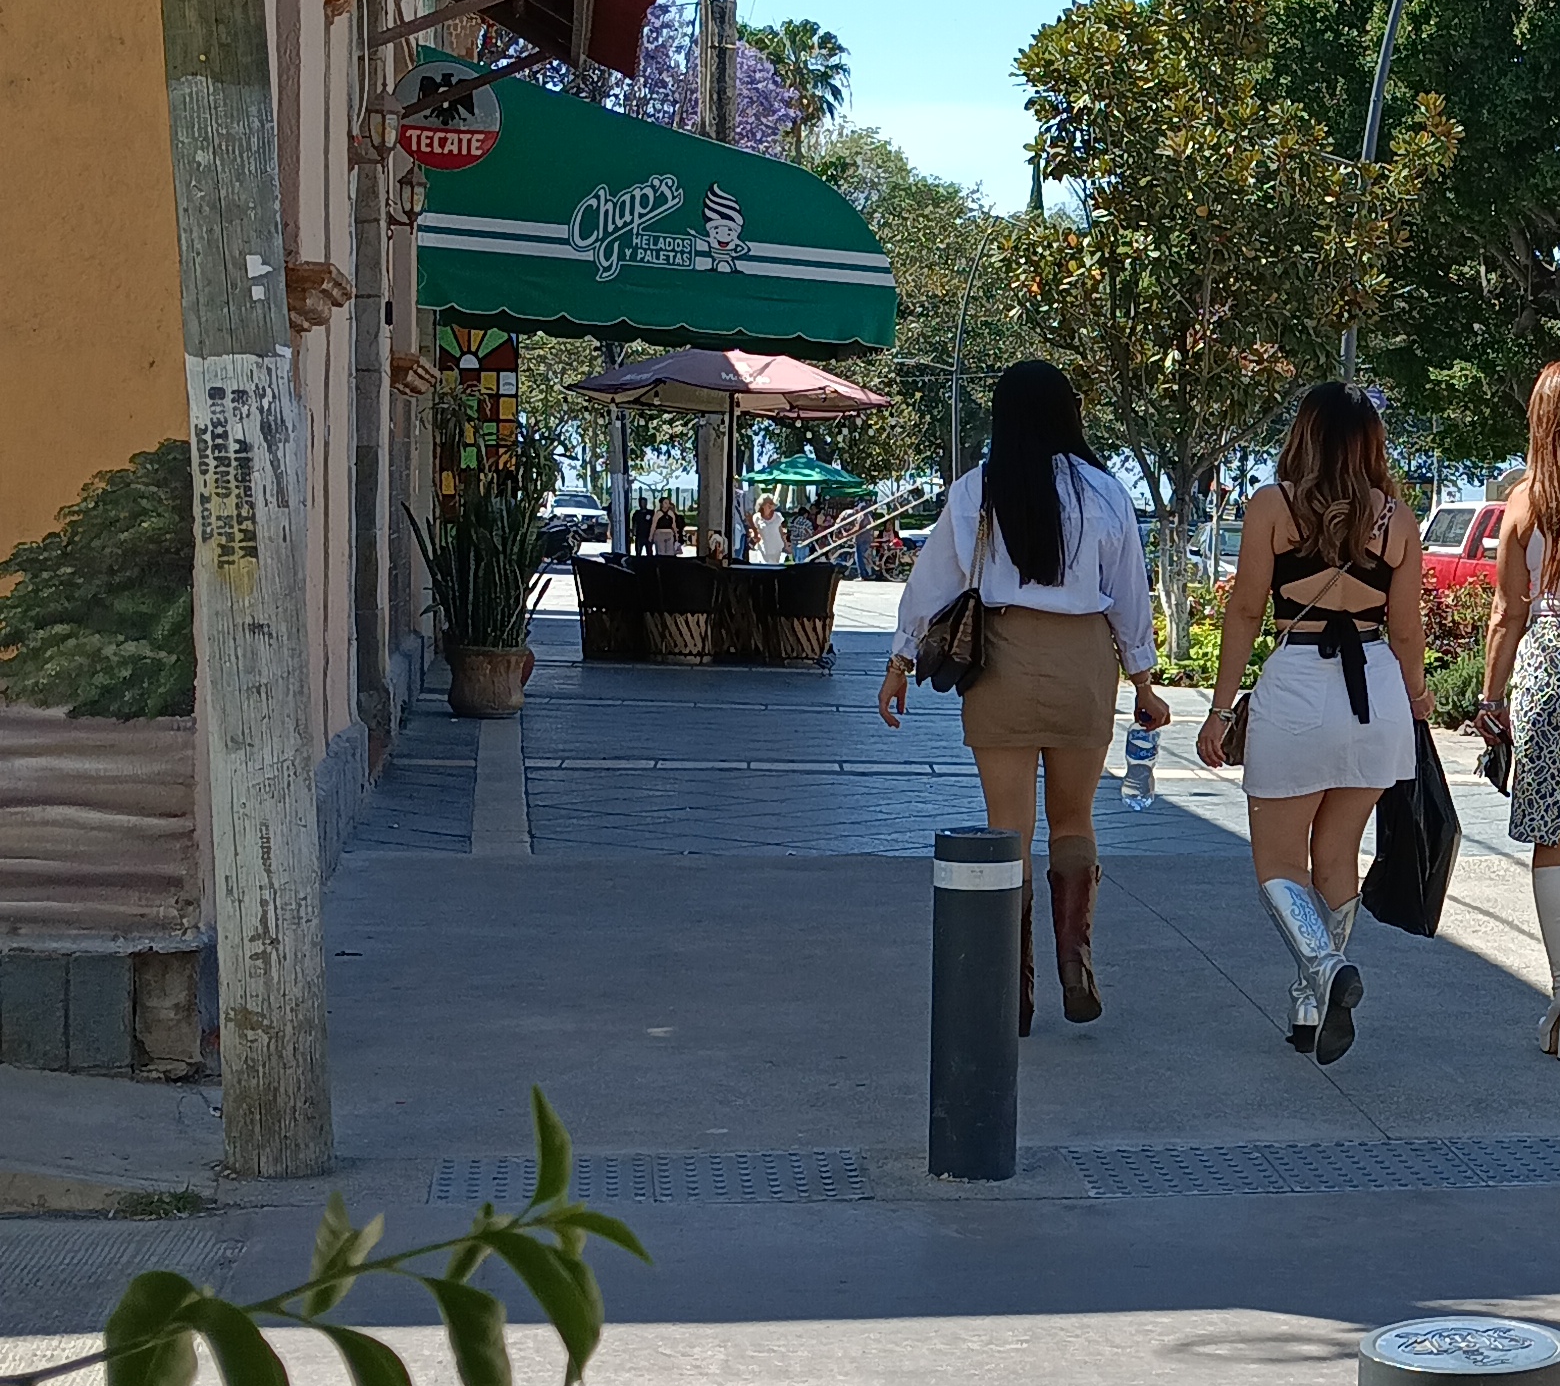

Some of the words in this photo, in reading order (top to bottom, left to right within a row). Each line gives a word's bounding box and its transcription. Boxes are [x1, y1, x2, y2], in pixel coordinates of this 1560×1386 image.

[405, 129, 486, 156] TECATE
[572, 174, 683, 273] Chap's
[632, 234, 691, 252] HELADOS
[624, 248, 632, 260] Y
[636, 249, 690, 266] PALETAS
